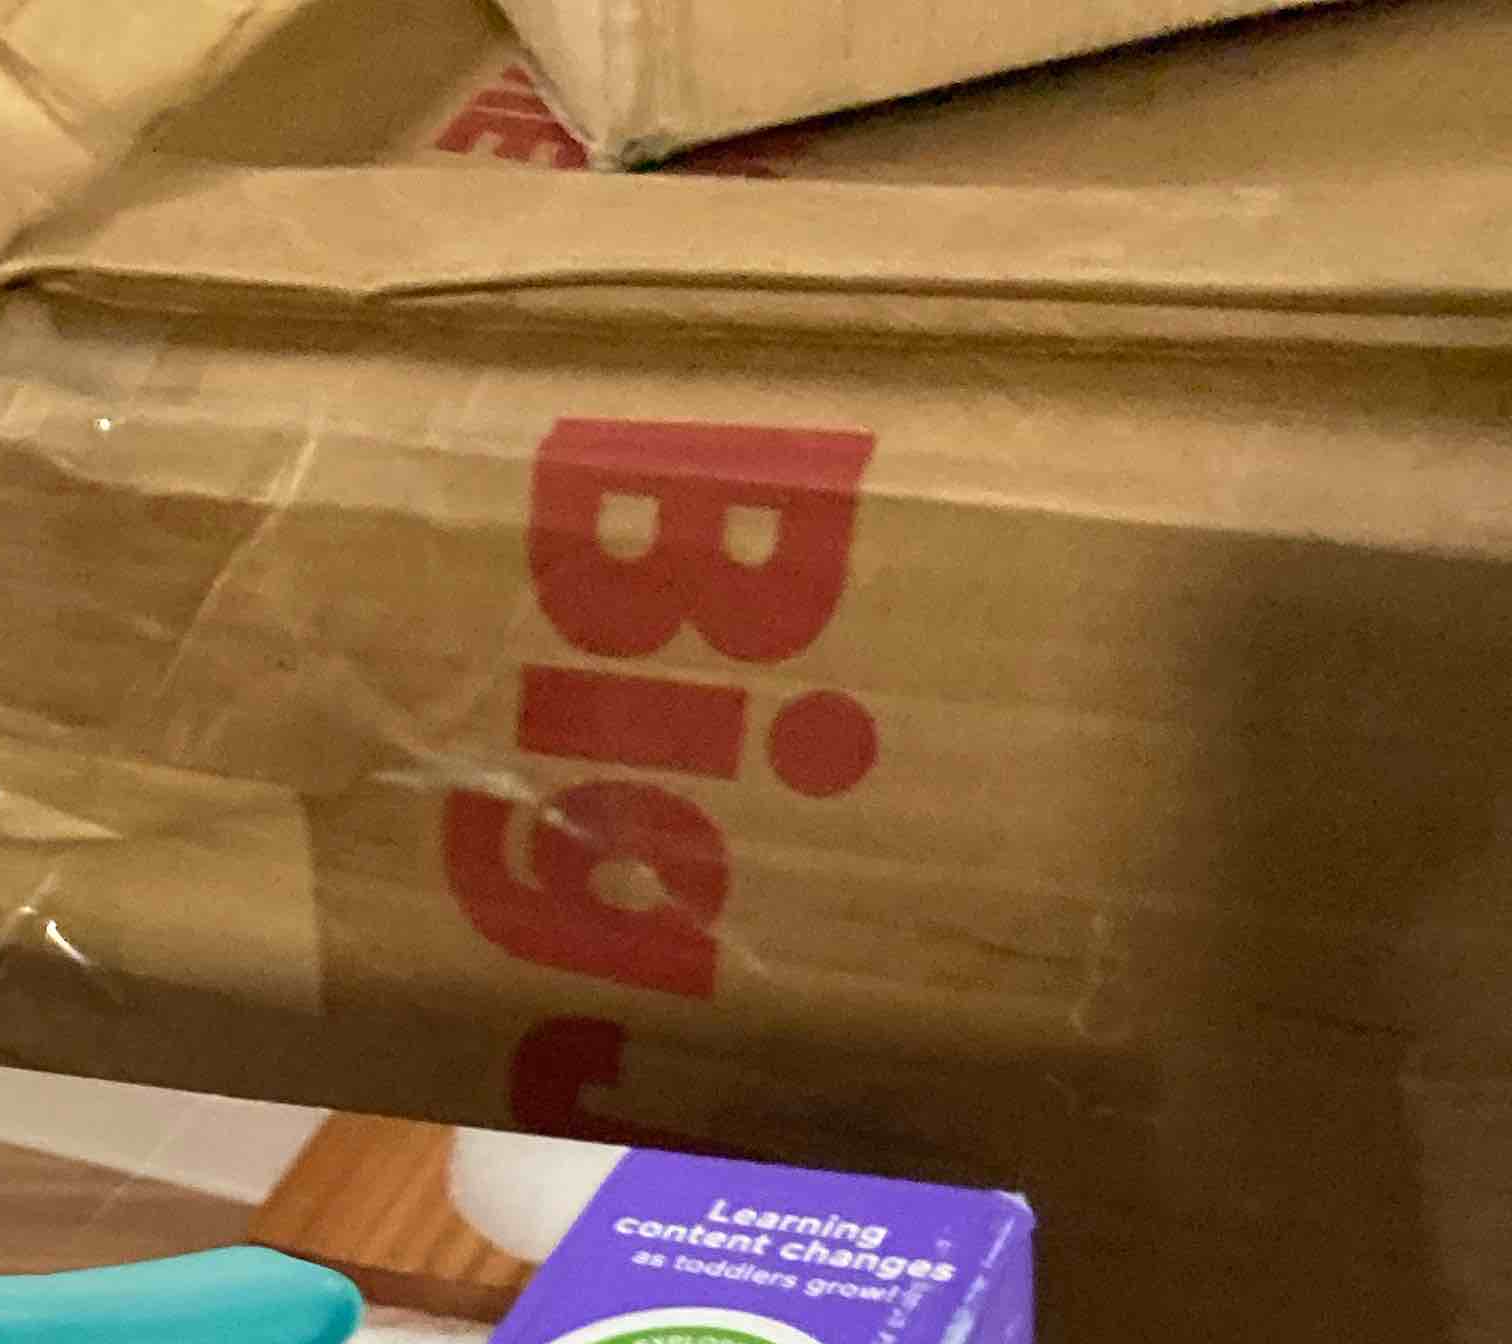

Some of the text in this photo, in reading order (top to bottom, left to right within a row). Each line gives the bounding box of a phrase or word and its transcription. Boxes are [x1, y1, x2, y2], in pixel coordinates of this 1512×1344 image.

[441, 418, 879, 1002] Big
[613, 1216, 957, 1282] content changes
[706, 1198, 889, 1249] Learning
[631, 1250, 666, 1269] as
[672, 1255, 798, 1289] toddlers
